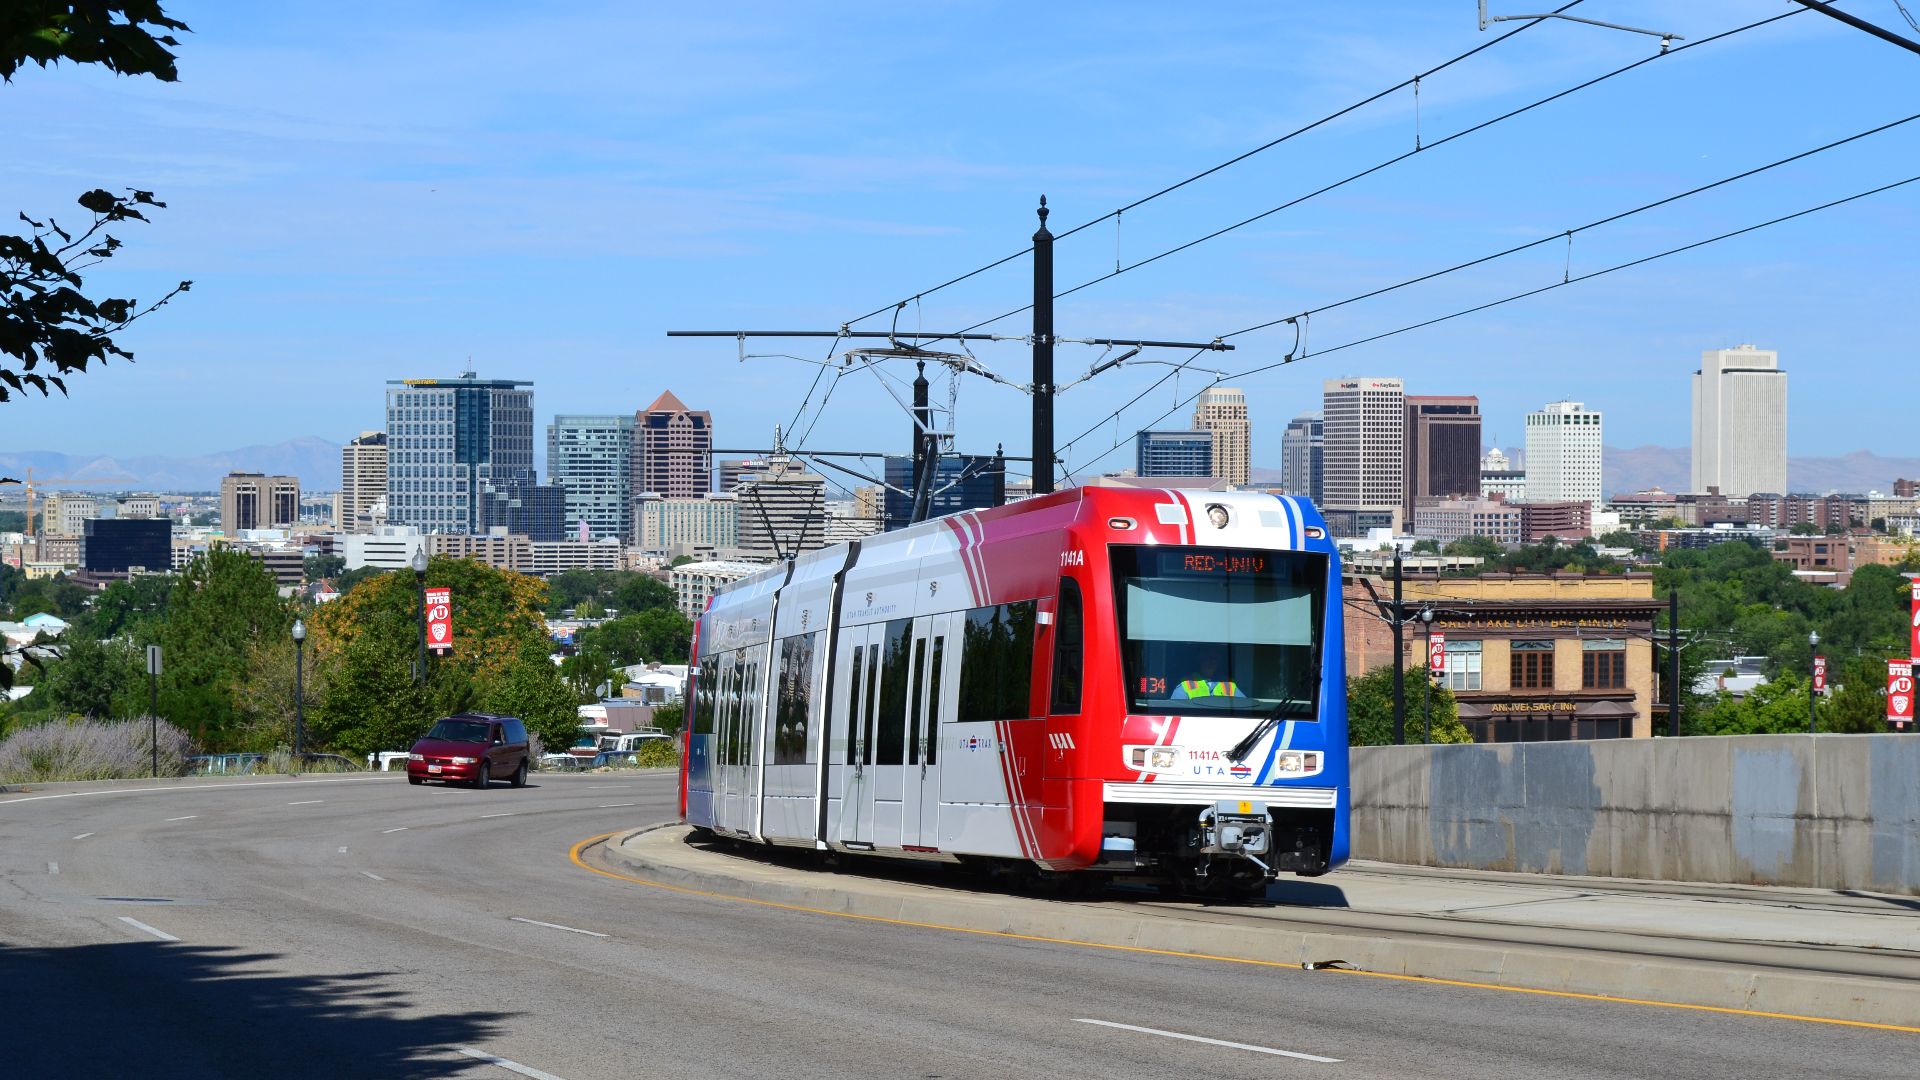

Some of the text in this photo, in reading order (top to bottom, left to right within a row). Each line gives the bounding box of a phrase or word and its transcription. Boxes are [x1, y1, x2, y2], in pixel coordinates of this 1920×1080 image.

[1060, 549, 1084, 567] 1141A
[1184, 554, 1265, 573] RED-UNIV
[427, 596, 449, 604] UTES
[1476, 618, 1513, 629] LAKE
[1889, 668, 1912, 676] UTES
[1491, 702, 1577, 712] ANNIVERSARY INN
[1188, 750, 1220, 761] 1141A
[1193, 765, 1225, 776] UTA
